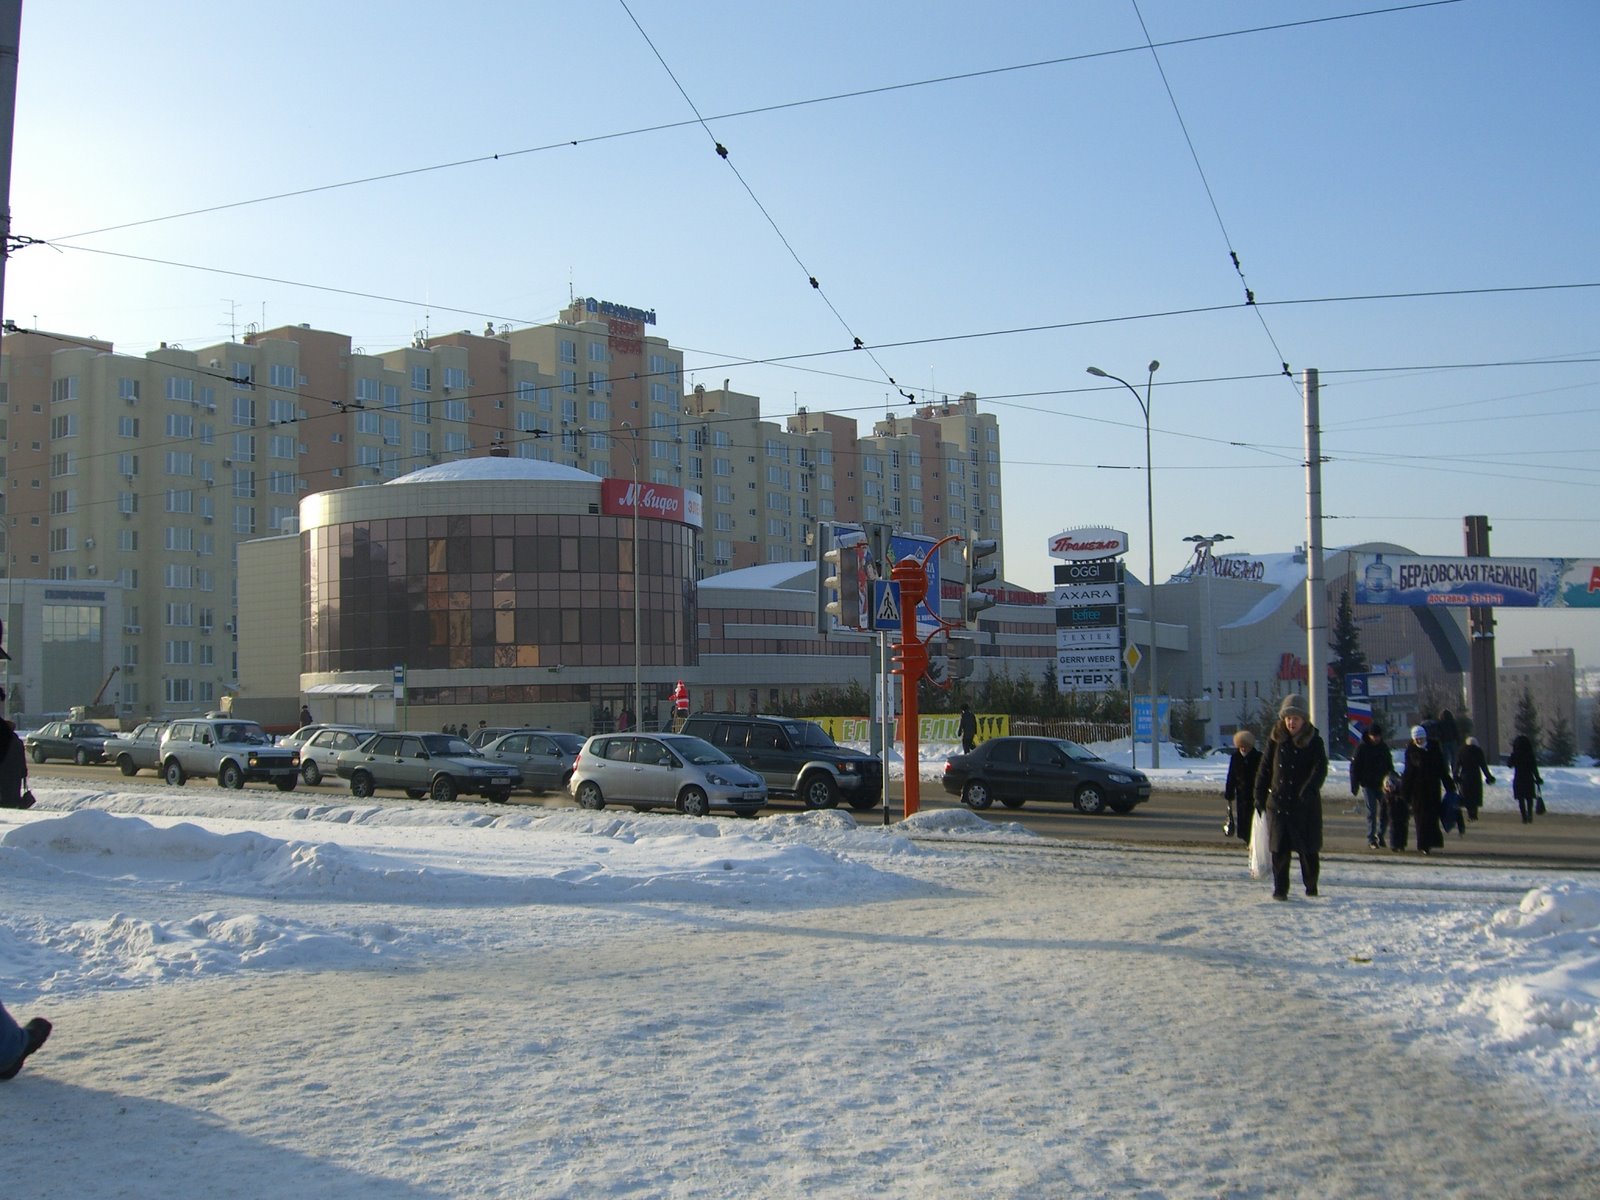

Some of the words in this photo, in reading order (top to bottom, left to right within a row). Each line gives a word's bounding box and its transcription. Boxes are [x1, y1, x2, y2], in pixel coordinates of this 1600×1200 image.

[1070, 565, 1100, 578] OGGI
[1400, 564, 1478, 591] БЕРДОВСКАЯ
[1480, 564, 1537, 594] ТАЕЖНАЯ
[1060, 590, 1112, 600] AXARA
[1072, 609, 1100, 621] befree
[1063, 631, 1111, 642] TEXIER
[1060, 655, 1085, 664] GERRY
[1087, 654, 1116, 664] WEBER
[1063, 674, 1114, 685] СТЕРХ
